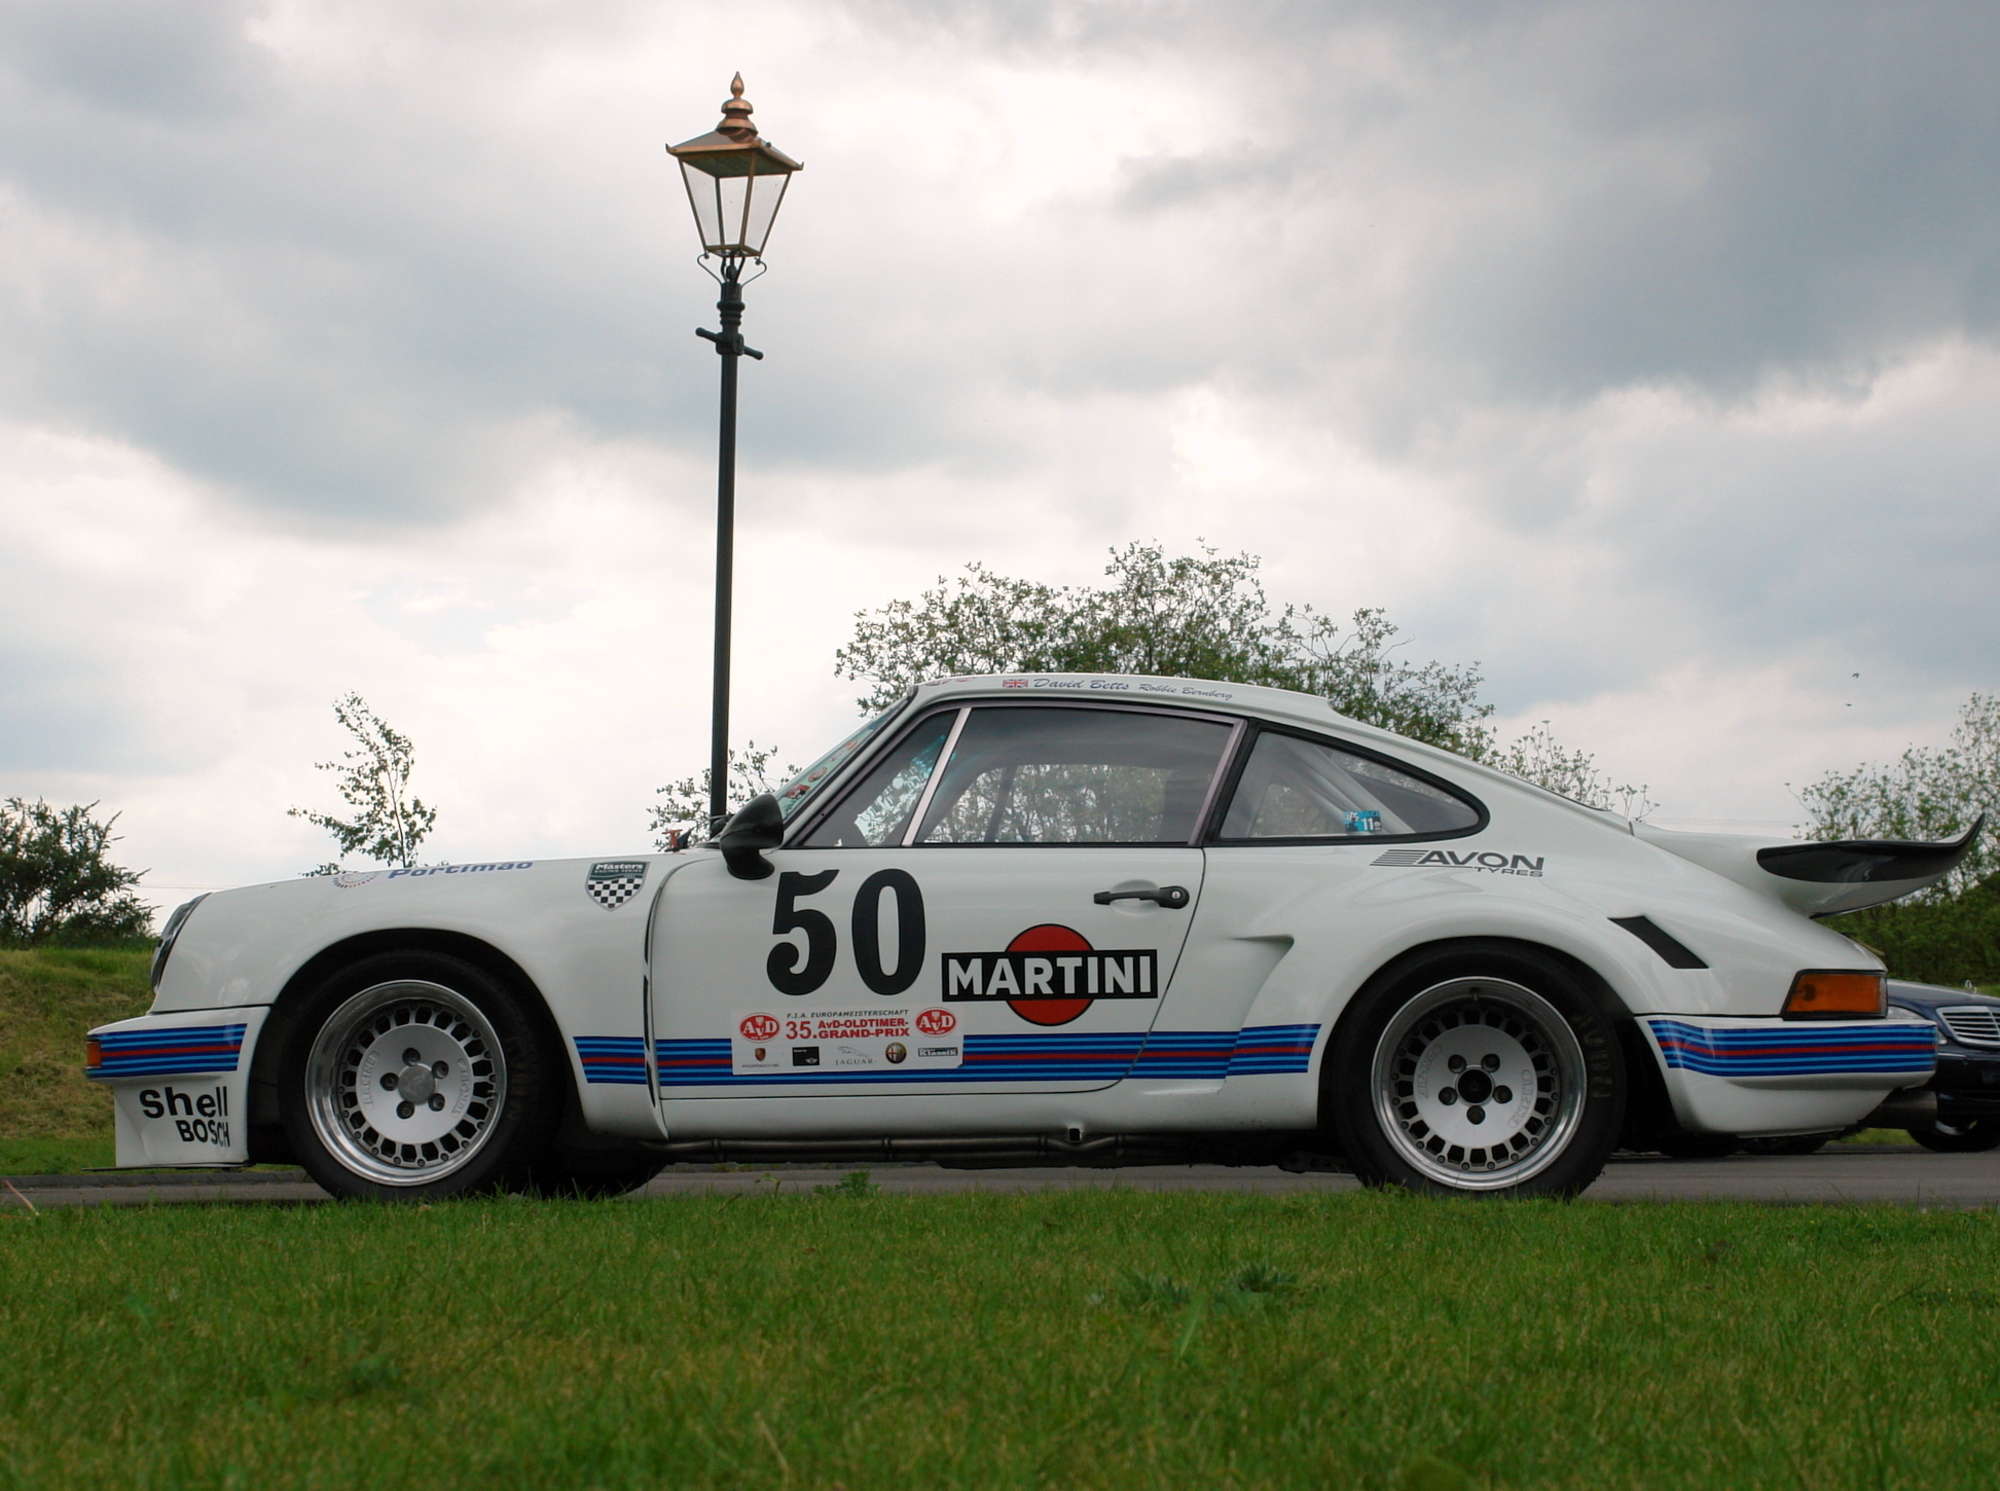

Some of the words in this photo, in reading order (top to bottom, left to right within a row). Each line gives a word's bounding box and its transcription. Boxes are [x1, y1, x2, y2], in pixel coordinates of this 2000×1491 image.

[1034, 678, 1082, 689] David
[1090, 680, 1129, 690] Betts
[595, 863, 643, 871] Masters
[1420, 850, 1544, 870] AVON
[1474, 866, 1543, 877] TYRES
[766, 868, 926, 996] 50
[948, 956, 1152, 996] MARTINI
[818, 1028, 910, 1039] GRAND-PRIX
[140, 1086, 228, 1118] Shell
[175, 1119, 231, 1148] BOSCH
